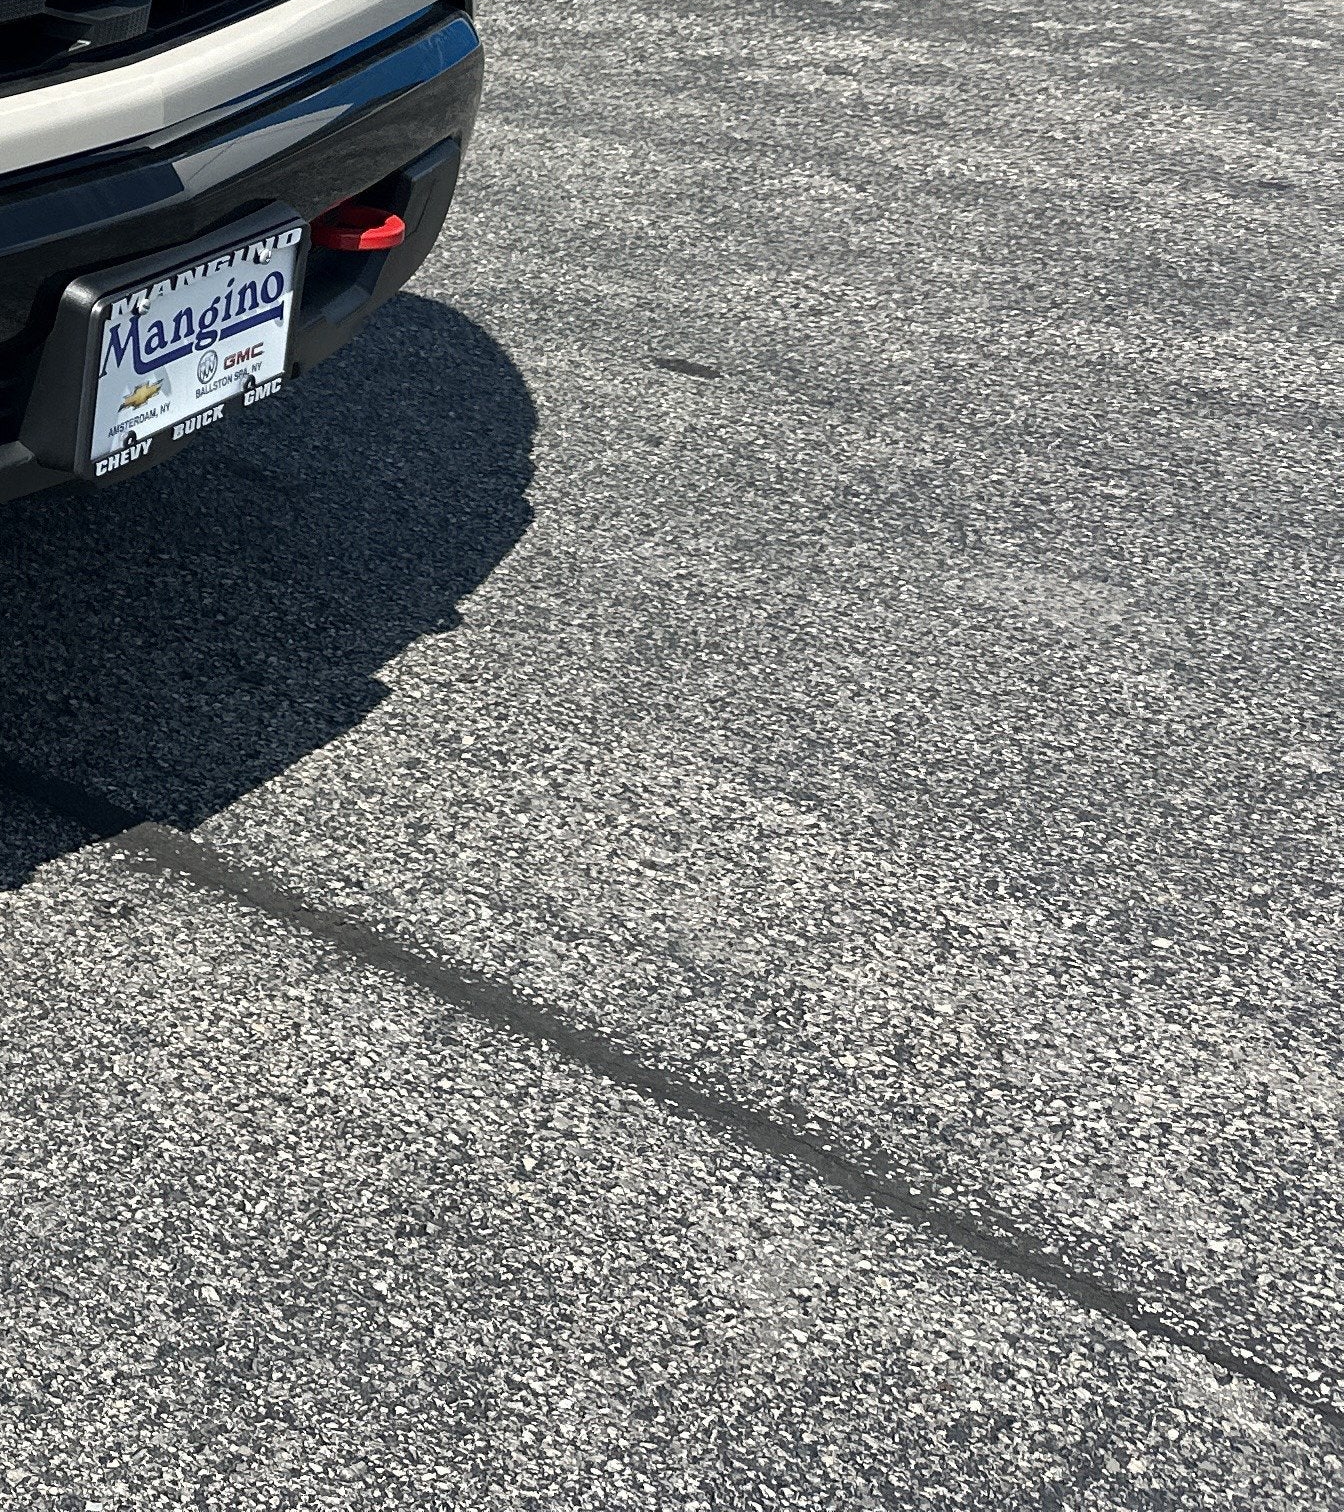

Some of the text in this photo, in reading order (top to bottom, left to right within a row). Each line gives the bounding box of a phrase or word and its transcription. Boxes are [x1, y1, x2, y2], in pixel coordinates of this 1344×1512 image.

[98, 270, 285, 378] Mangino
[223, 343, 264, 370] GMC
[251, 361, 263, 373] NY
[159, 401, 171, 415] NY
[95, 377, 283, 477] CHEVY BUICK GMC
